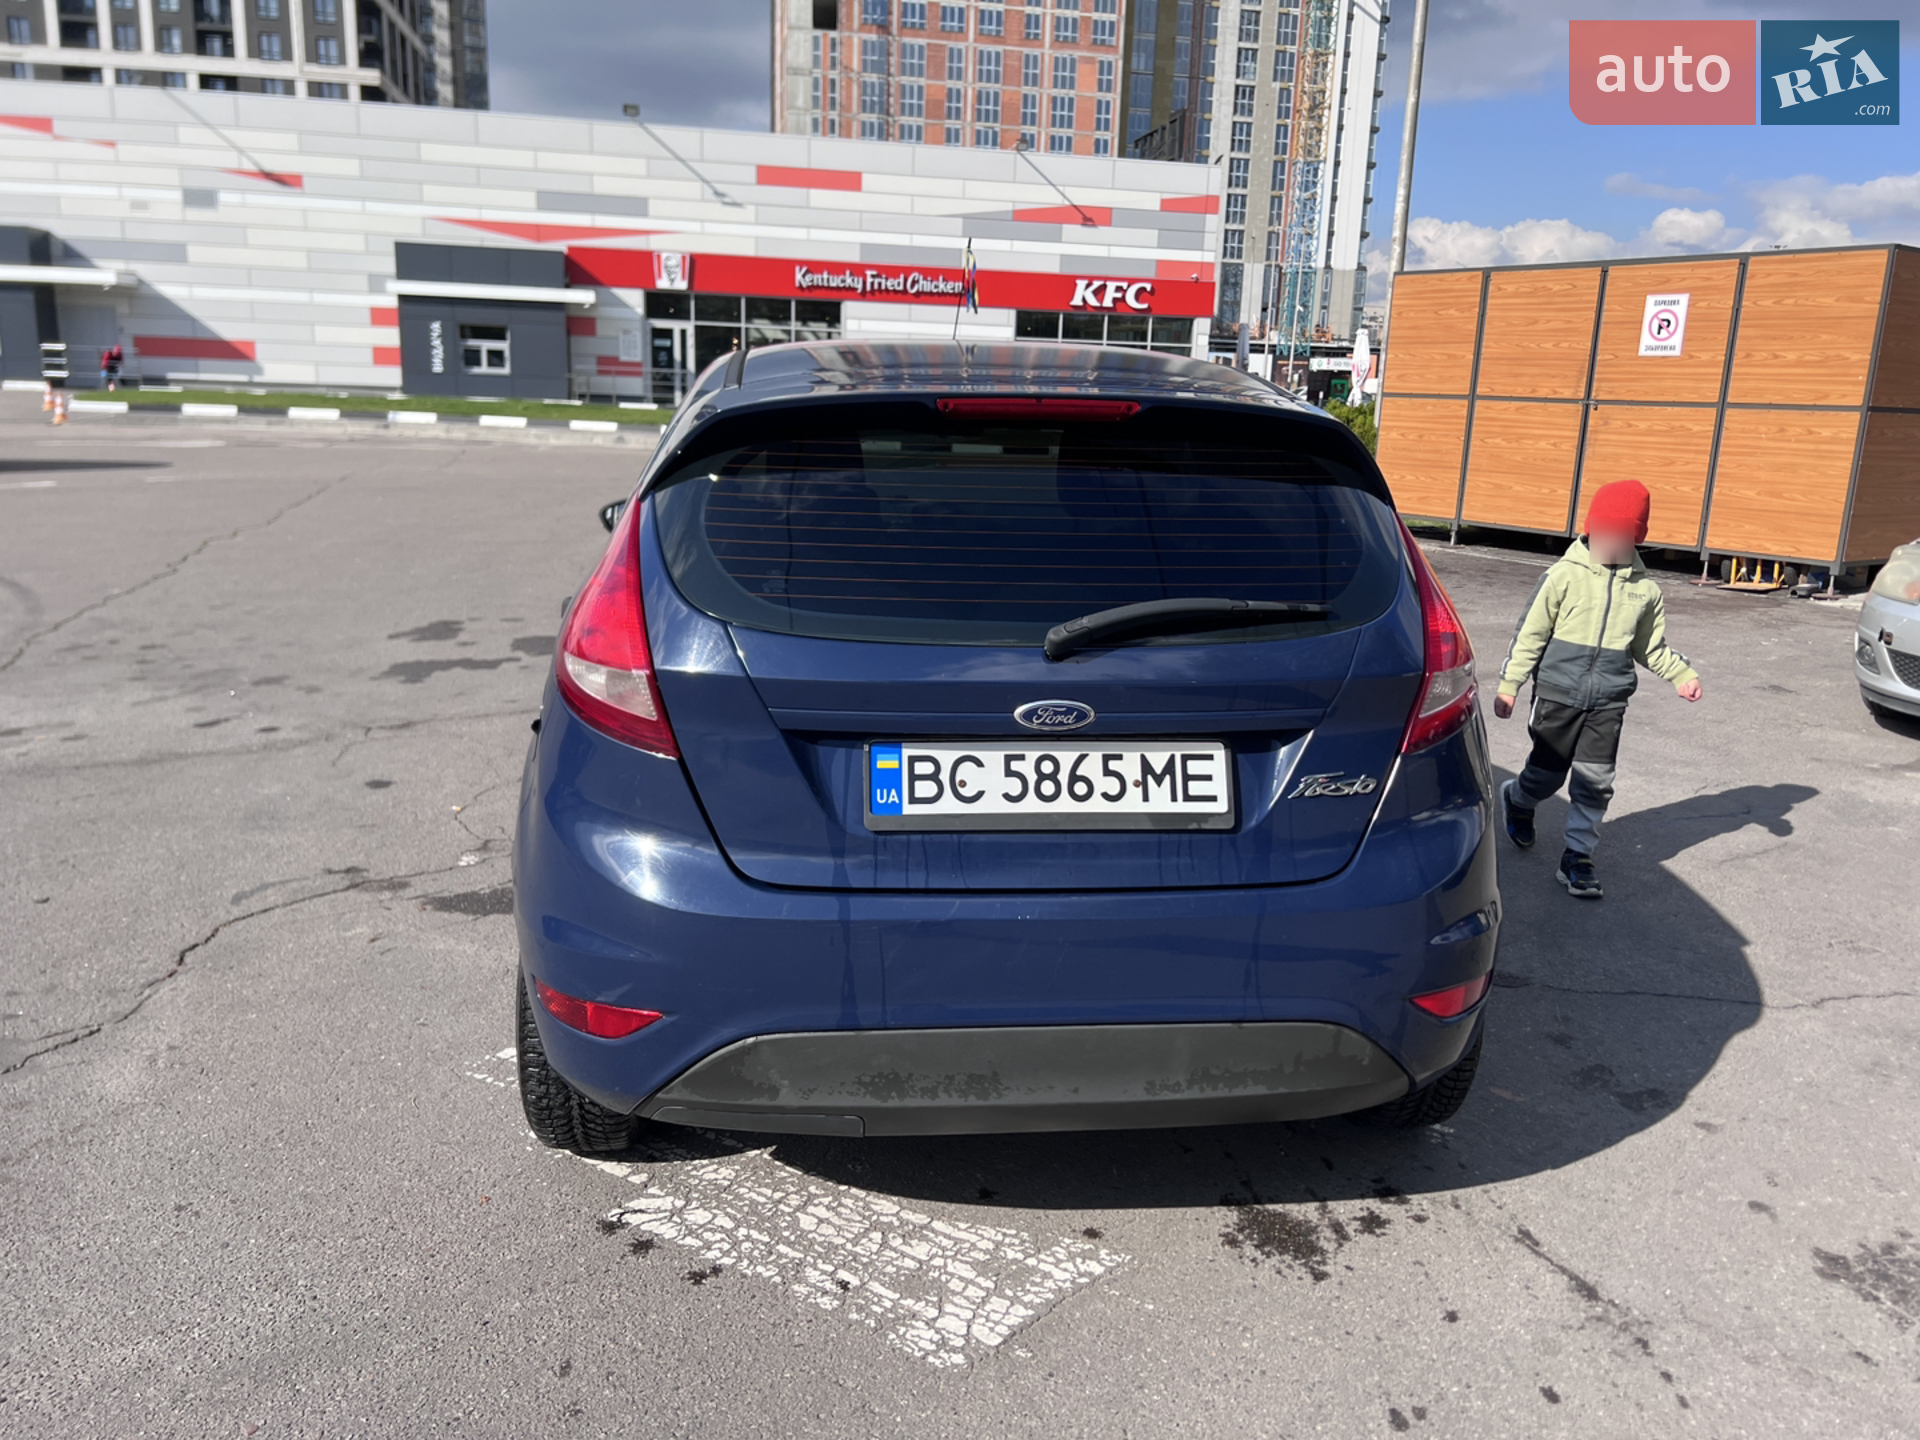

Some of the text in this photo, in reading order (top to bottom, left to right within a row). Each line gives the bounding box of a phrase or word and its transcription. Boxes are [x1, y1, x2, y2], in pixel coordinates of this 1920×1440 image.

[795, 266, 964, 294] Kentucky Fried Chicken
[1069, 279, 1152, 310] KFC
[1032, 707, 1078, 725] Ford
[876, 753, 1218, 804] UA BC 5865 ME
[1287, 771, 1377, 799] Fiesta
